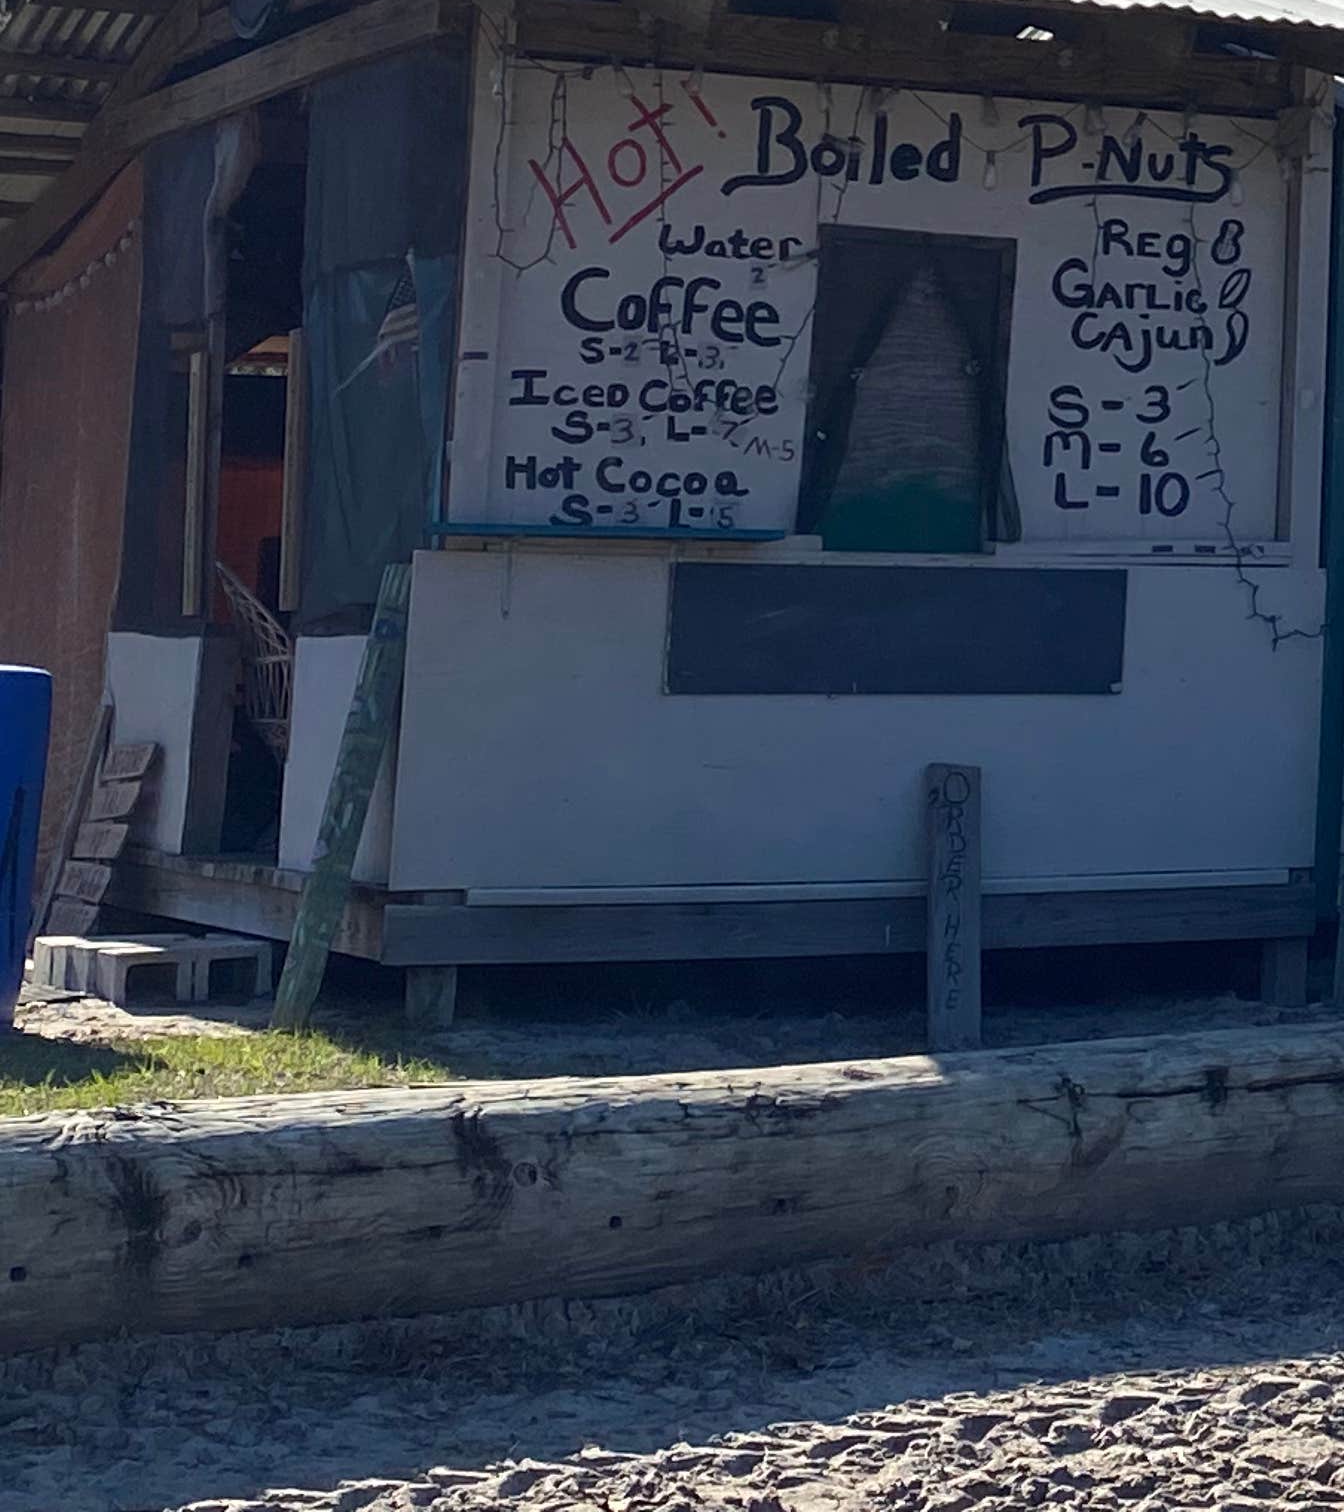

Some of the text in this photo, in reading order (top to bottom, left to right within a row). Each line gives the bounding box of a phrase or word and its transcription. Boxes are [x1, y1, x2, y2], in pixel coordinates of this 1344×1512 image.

[720, 95, 1236, 205] Boiled P-Nuts
[658, 223, 803, 261] Water
[560, 267, 782, 347] Coffee
[638, 378, 779, 416] Coffee
[505, 455, 750, 497] Hot Cocoa
